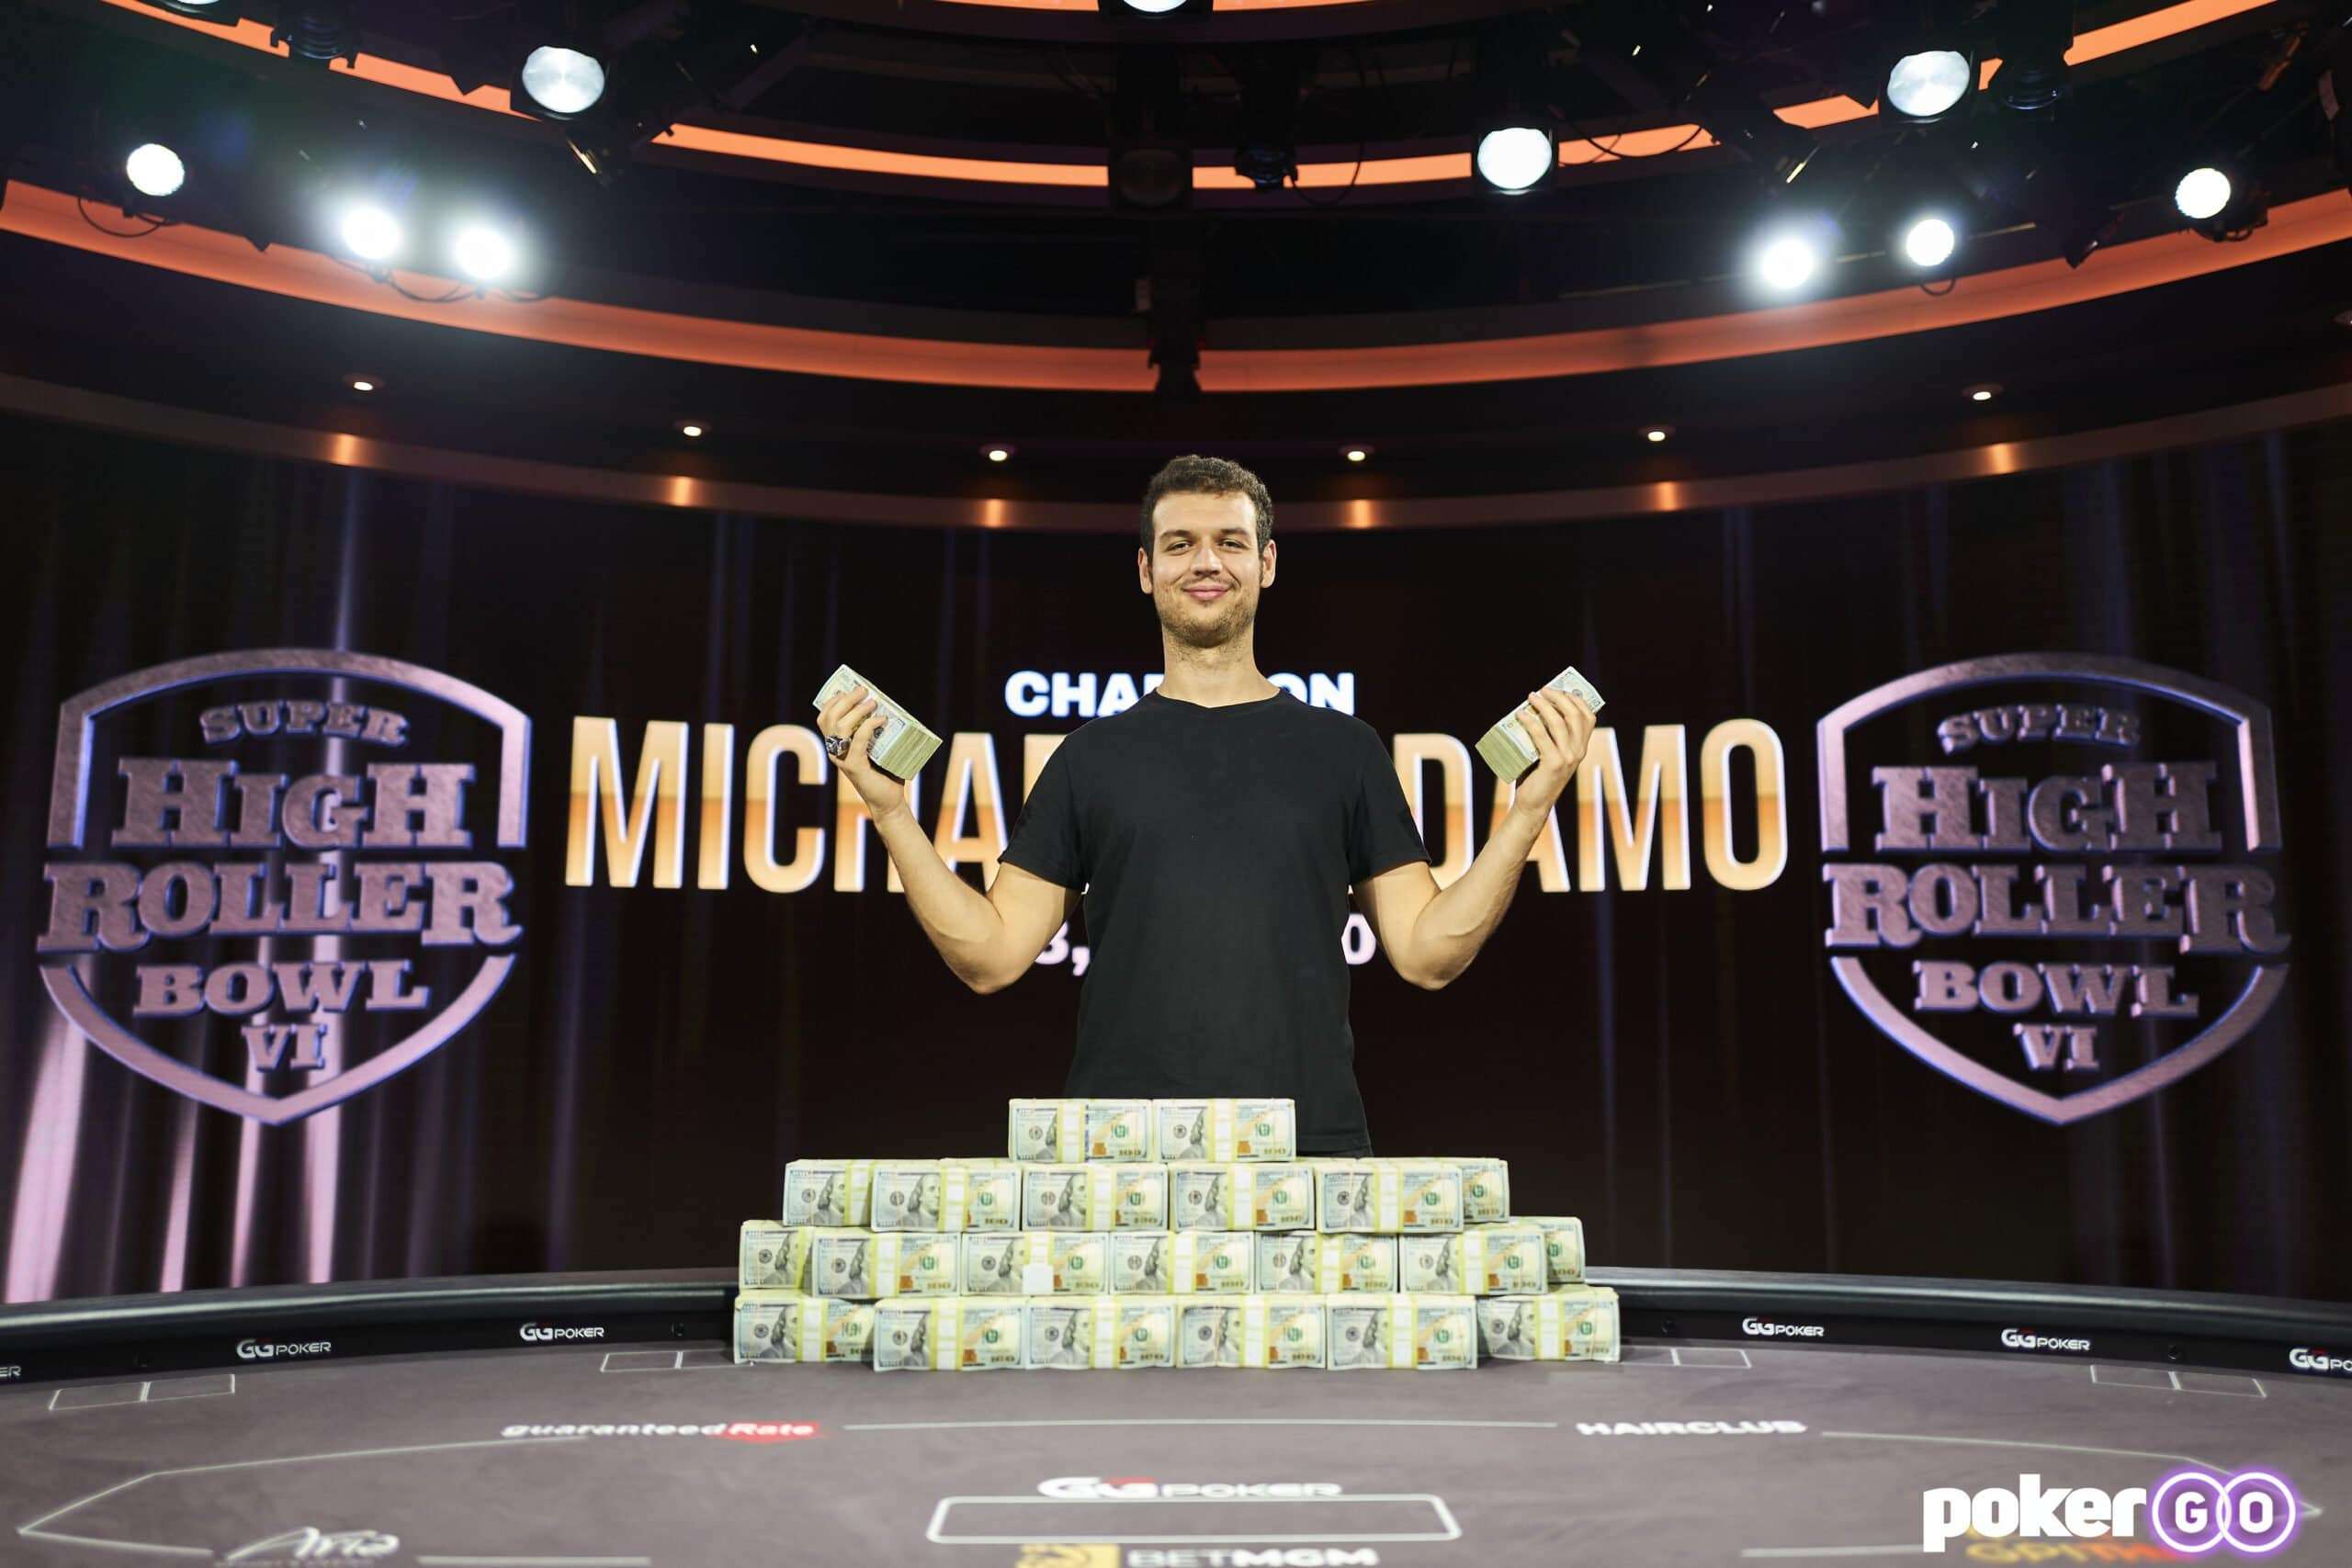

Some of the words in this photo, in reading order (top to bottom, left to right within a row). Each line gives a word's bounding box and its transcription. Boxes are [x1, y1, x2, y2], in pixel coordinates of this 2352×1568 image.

[199, 699, 410, 746] SUPER
[1937, 704, 2139, 754] SUPER
[111, 758, 476, 849] HIGH
[1872, 761, 2222, 852] HIGH
[37, 862, 523, 953] ROLLER
[1823, 863, 2291, 953] ROLLER
[133, 959, 432, 1018] BOWL
[1913, 960, 2199, 1017] BOWL
[242, 1022, 327, 1070] VI
[2013, 1022, 2099, 1070] VI
